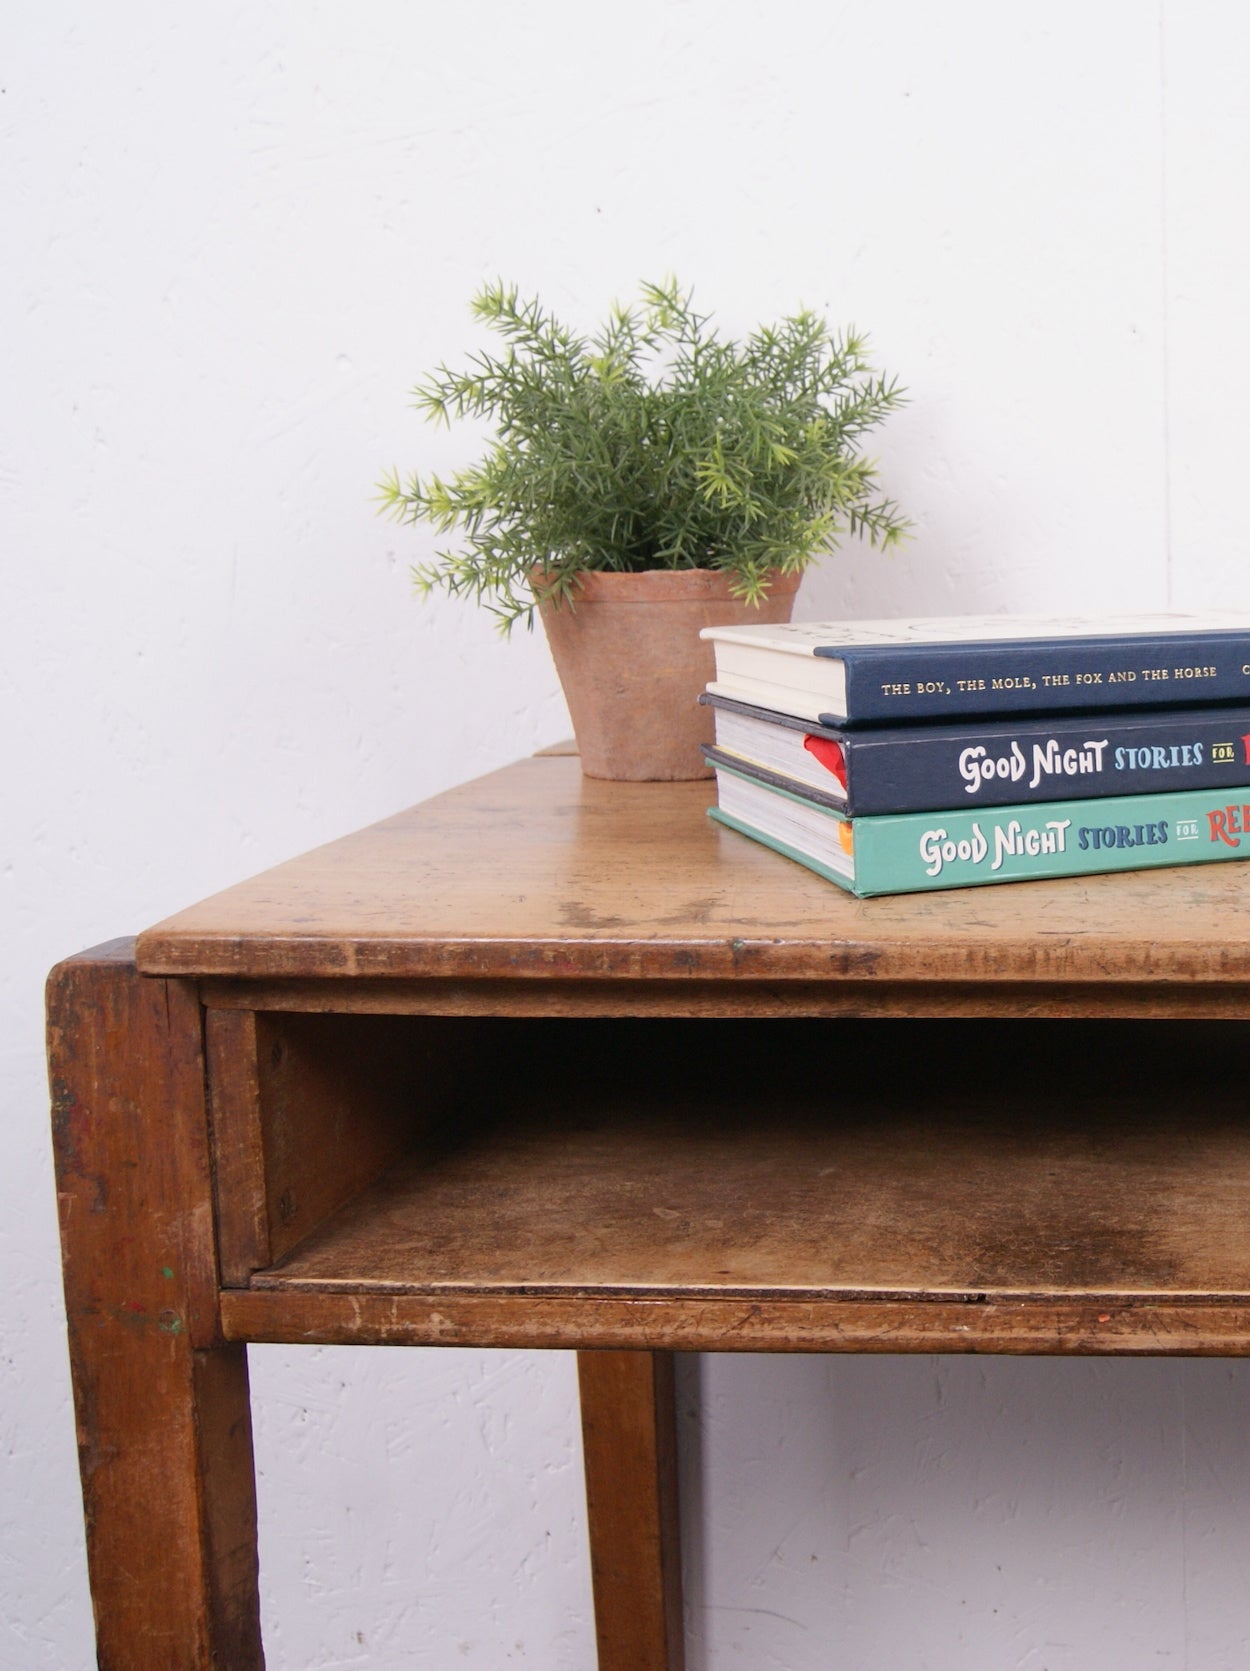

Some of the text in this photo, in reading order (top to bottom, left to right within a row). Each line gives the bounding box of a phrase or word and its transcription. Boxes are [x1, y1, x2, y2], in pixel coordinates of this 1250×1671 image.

[881, 666, 1217, 696] THE BOY, THE MOLE, THE FOX AND THE HORSE
[1114, 742, 1204, 771] STORIES
[1212, 747, 1235, 760] FOR
[1078, 820, 1169, 851] STORIES
[1176, 824, 1199, 837] FOR
